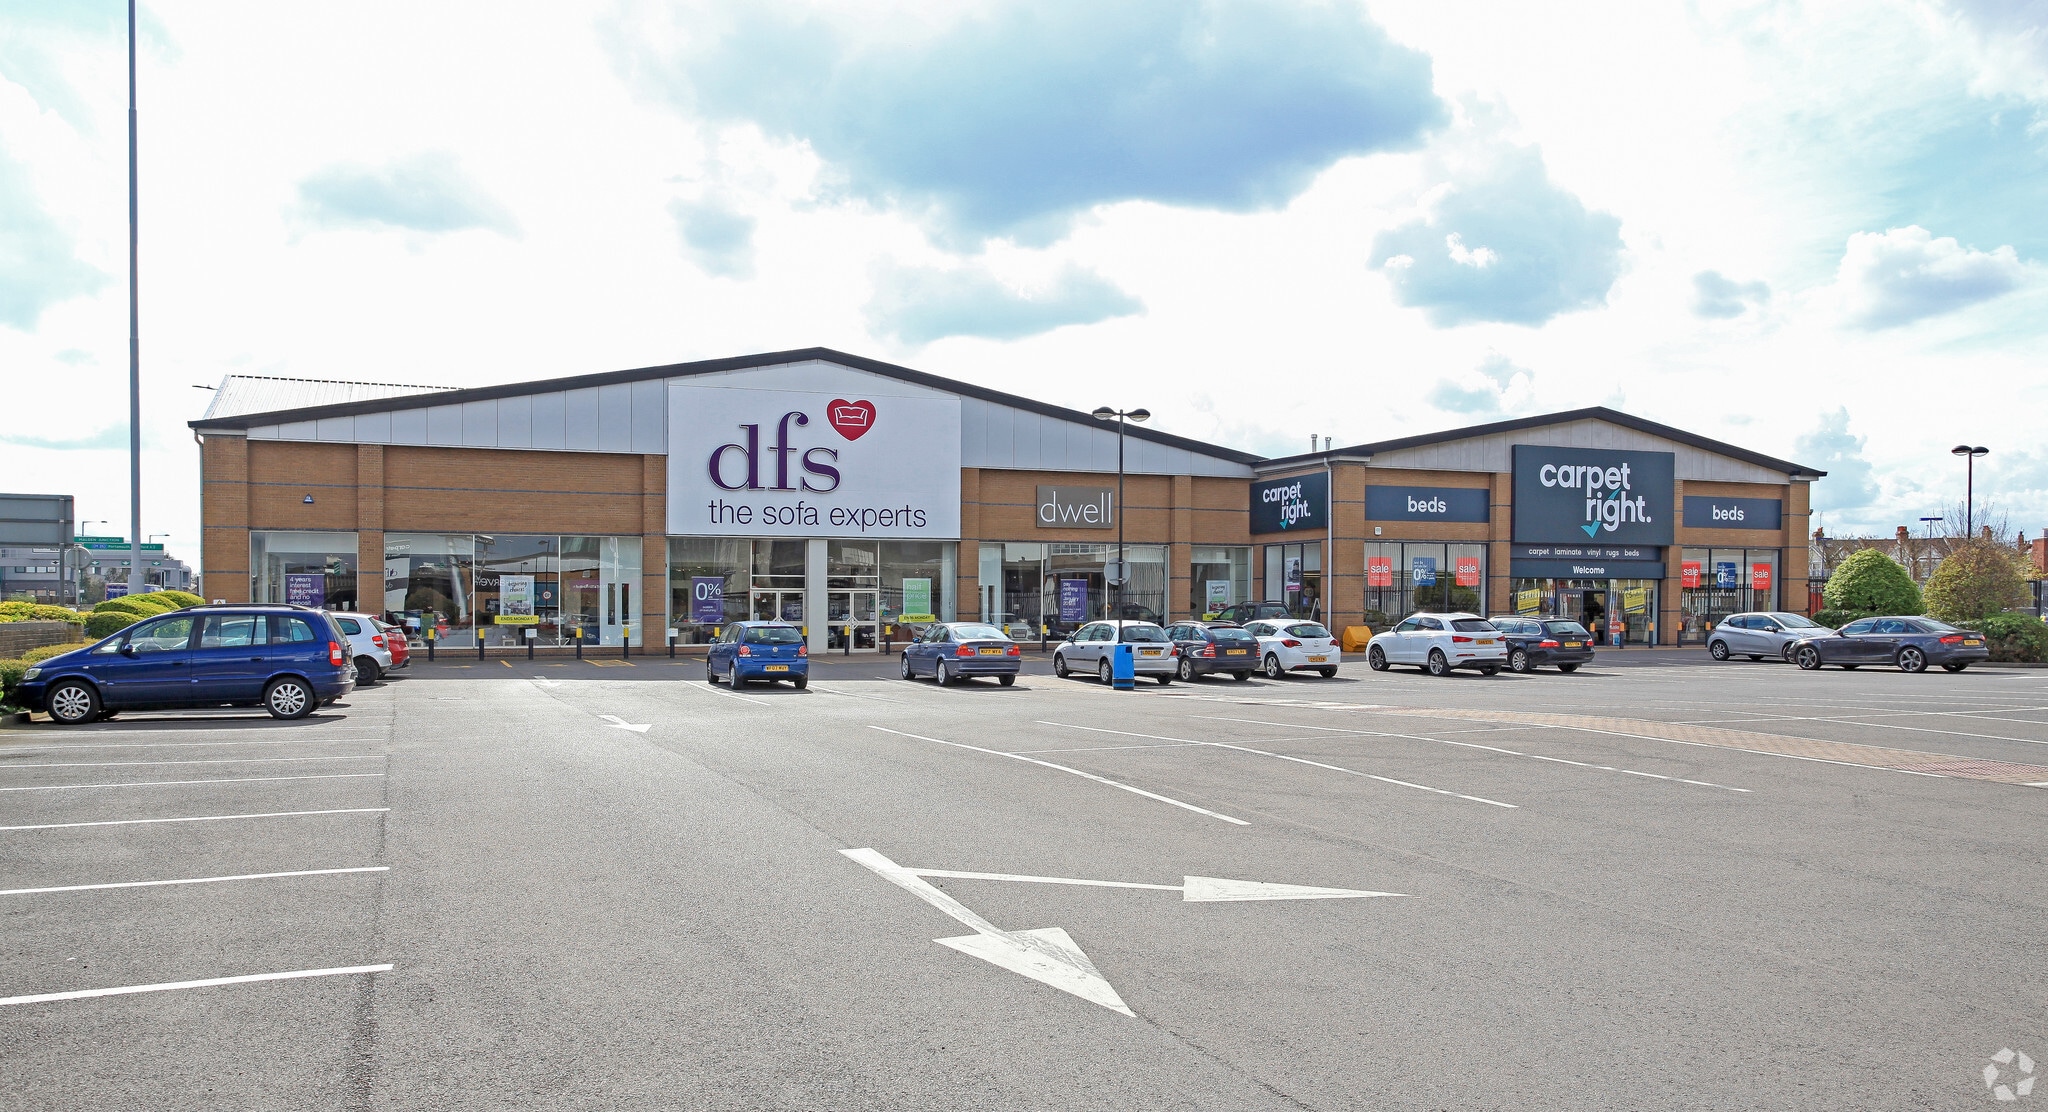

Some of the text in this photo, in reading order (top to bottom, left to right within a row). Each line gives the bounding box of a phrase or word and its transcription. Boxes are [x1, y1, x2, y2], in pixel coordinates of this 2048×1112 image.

[708, 411, 841, 493] dfs
[1540, 463, 1631, 498] carpet
[1263, 482, 1302, 506] carpet
[1040, 491, 1111, 523] dwell
[1408, 496, 1447, 513] beds
[708, 498, 927, 533] the sofa experts
[1713, 505, 1745, 521] beds
[1528, 548, 1640, 558] carpet laminate vinyl rugs beds
[1370, 563, 1389, 574] sale
[1458, 564, 1477, 574] sale
[1572, 565, 1605, 575] Welcome
[1683, 566, 1699, 576] sale
[1754, 569, 1769, 579] sale
[695, 582, 721, 601] 0%
[906, 582, 923, 591] half
